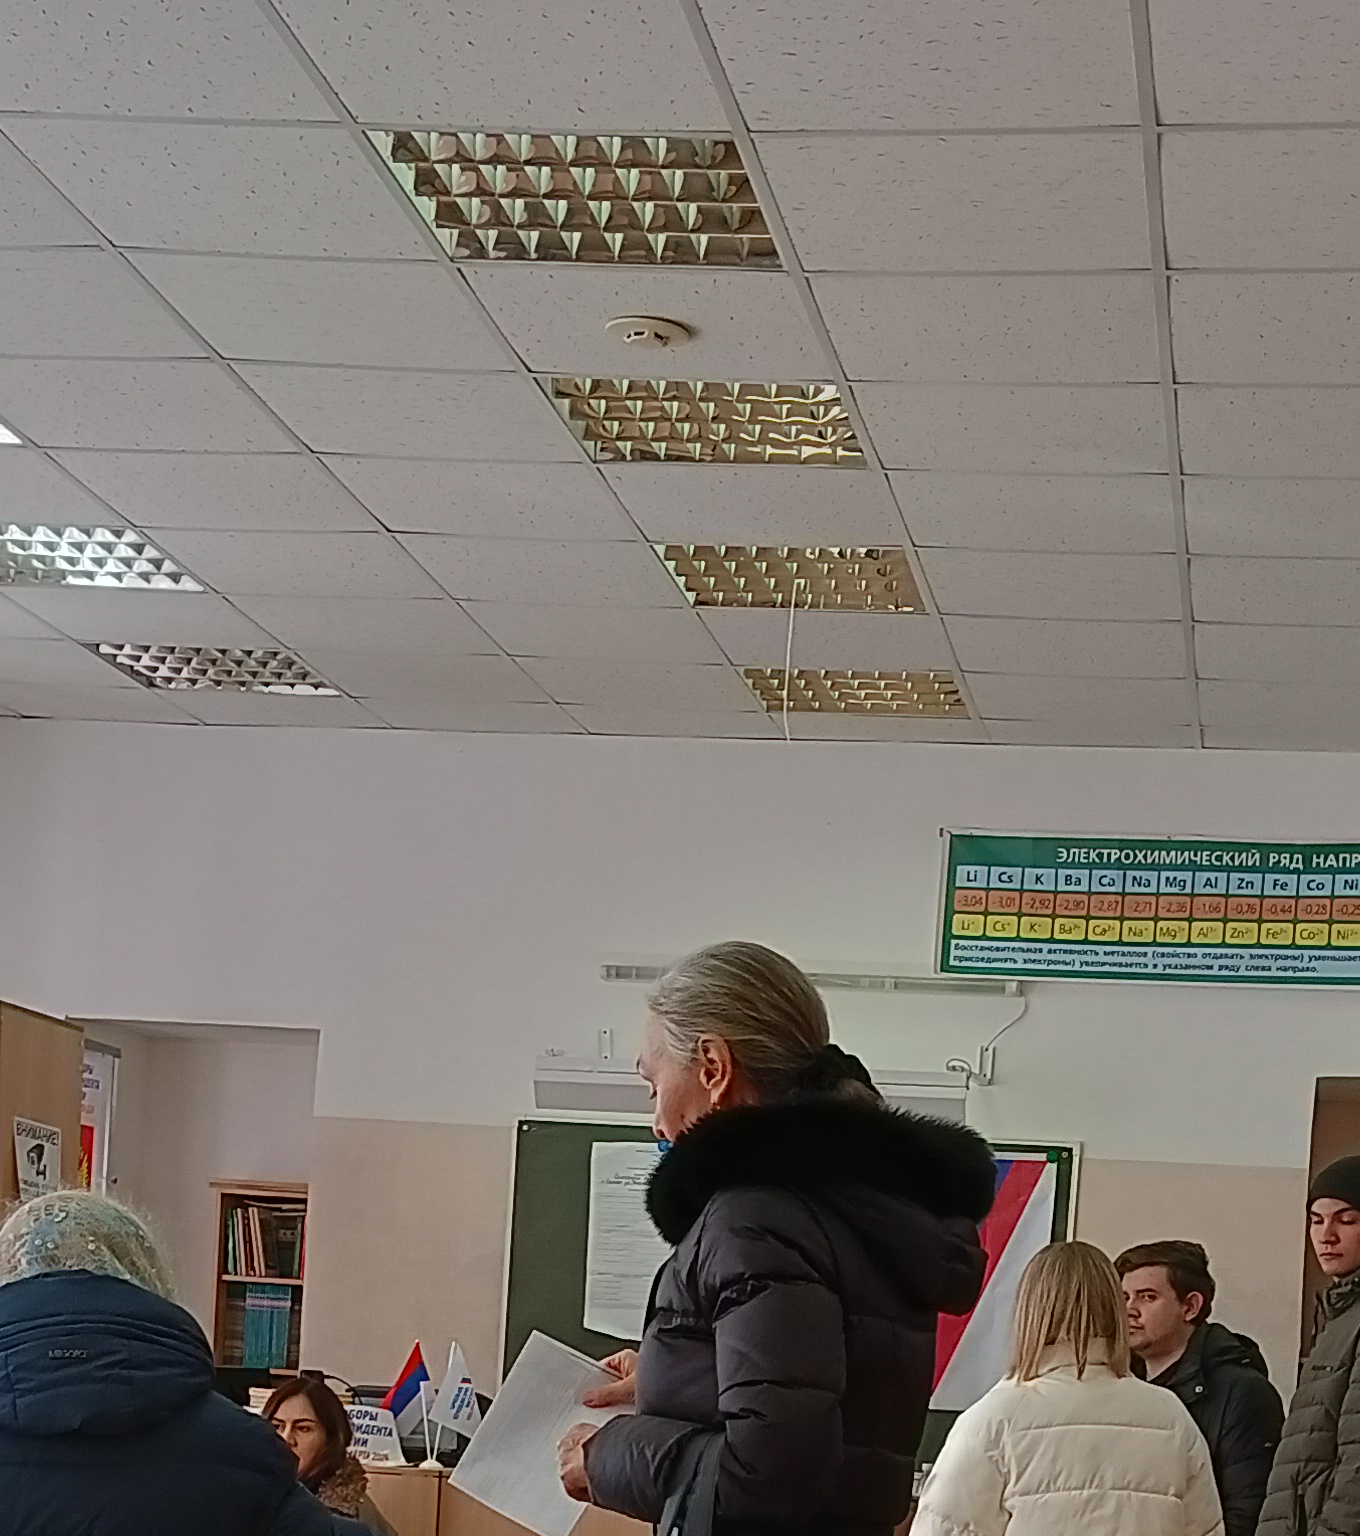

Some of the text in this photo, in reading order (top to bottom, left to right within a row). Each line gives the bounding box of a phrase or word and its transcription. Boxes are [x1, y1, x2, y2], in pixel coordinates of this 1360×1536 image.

[1056, 847, 1260, 866] ЭЛЕКТРОХИМИЧЕСКИЙ
[1268, 852, 1304, 871] РЯД
[966, 870, 978, 883] Li
[997, 871, 1014, 884] Cs
[1034, 873, 1045, 886] K
[1064, 874, 1082, 887] Ba
[1098, 875, 1116, 887] Ca
[1131, 875, 1151, 888] Na
[1165, 876, 1187, 891] Mg
[1203, 877, 1219, 889] Al
[1237, 878, 1255, 890] Zn
[1272, 878, 1289, 891] Fe
[1306, 879, 1325, 892] Co
[1343, 879, 1359, 891] Ni
